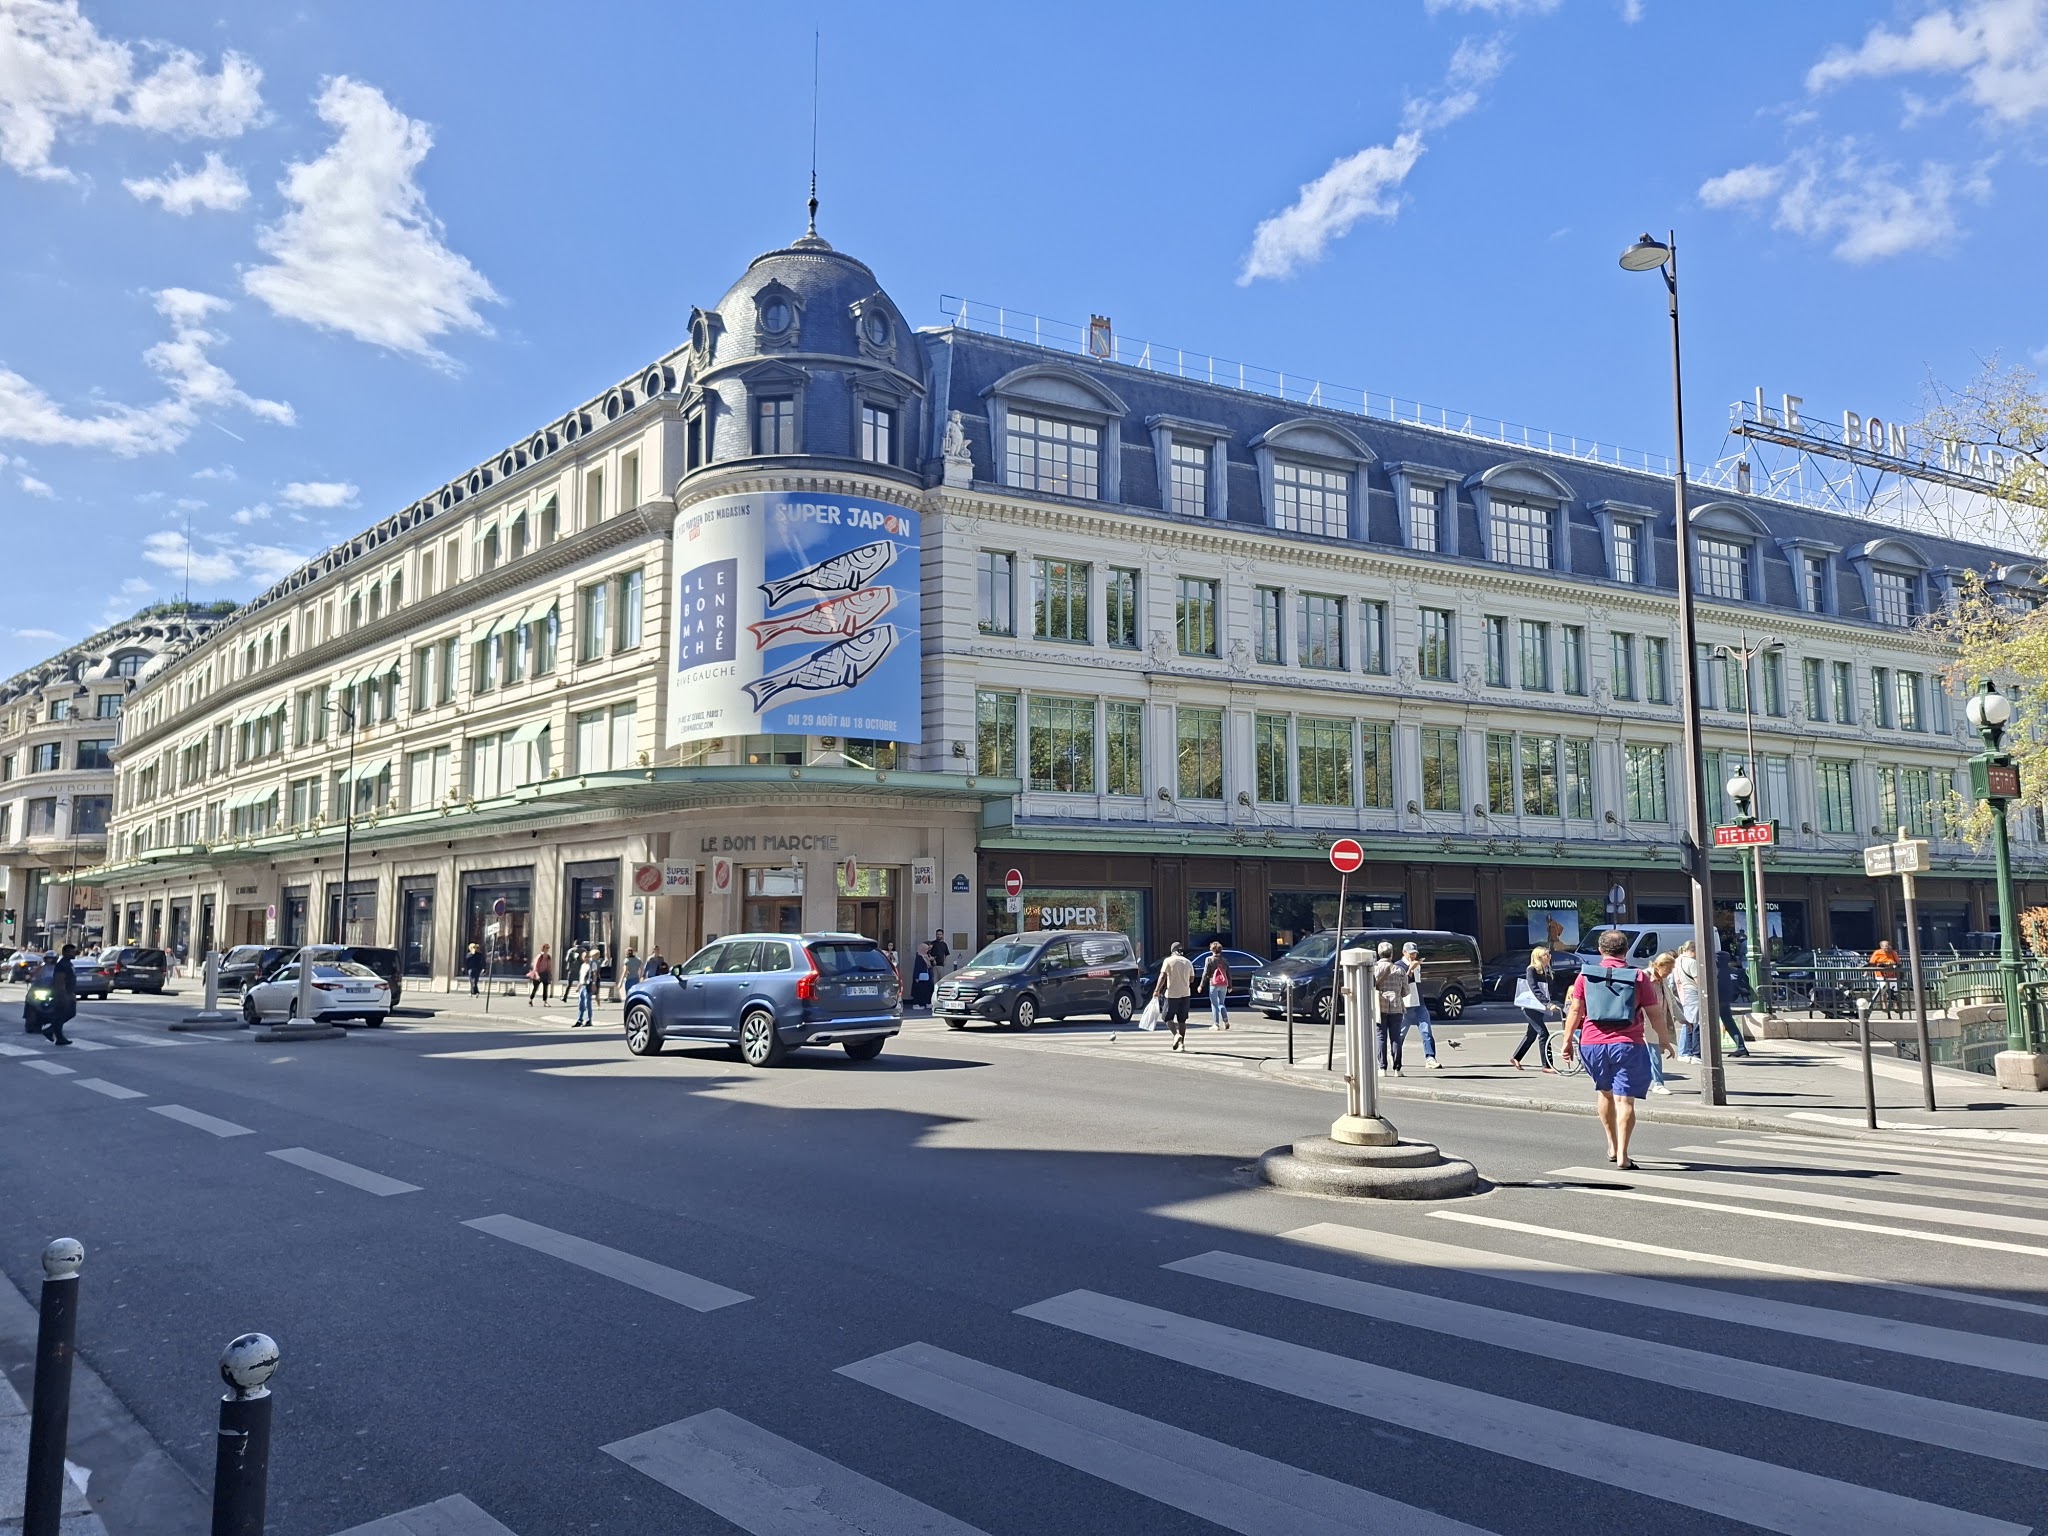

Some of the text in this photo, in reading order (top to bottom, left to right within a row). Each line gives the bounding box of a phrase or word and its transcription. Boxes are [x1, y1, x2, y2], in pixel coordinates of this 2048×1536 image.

[1756, 386, 1805, 434] LE
[1843, 410, 1908, 460] BON
[704, 510, 715, 523] DES
[716, 504, 751, 520] MAGASINS
[776, 503, 910, 537] SUPER JAPON
[692, 666, 736, 682] GAUCHE
[788, 713, 897, 732] DU 29 AOÛT AU 18 OCTOBRE
[48, 785, 63, 793] AU
[67, 783, 96, 792] BON
[701, 834, 839, 852] LE BON MARCHE
[666, 867, 690, 875] SUPER
[914, 866, 931, 874] SUPER
[1527, 900, 1577, 908] LOUIS VUITTON
[1041, 907, 1097, 926] SUPER
